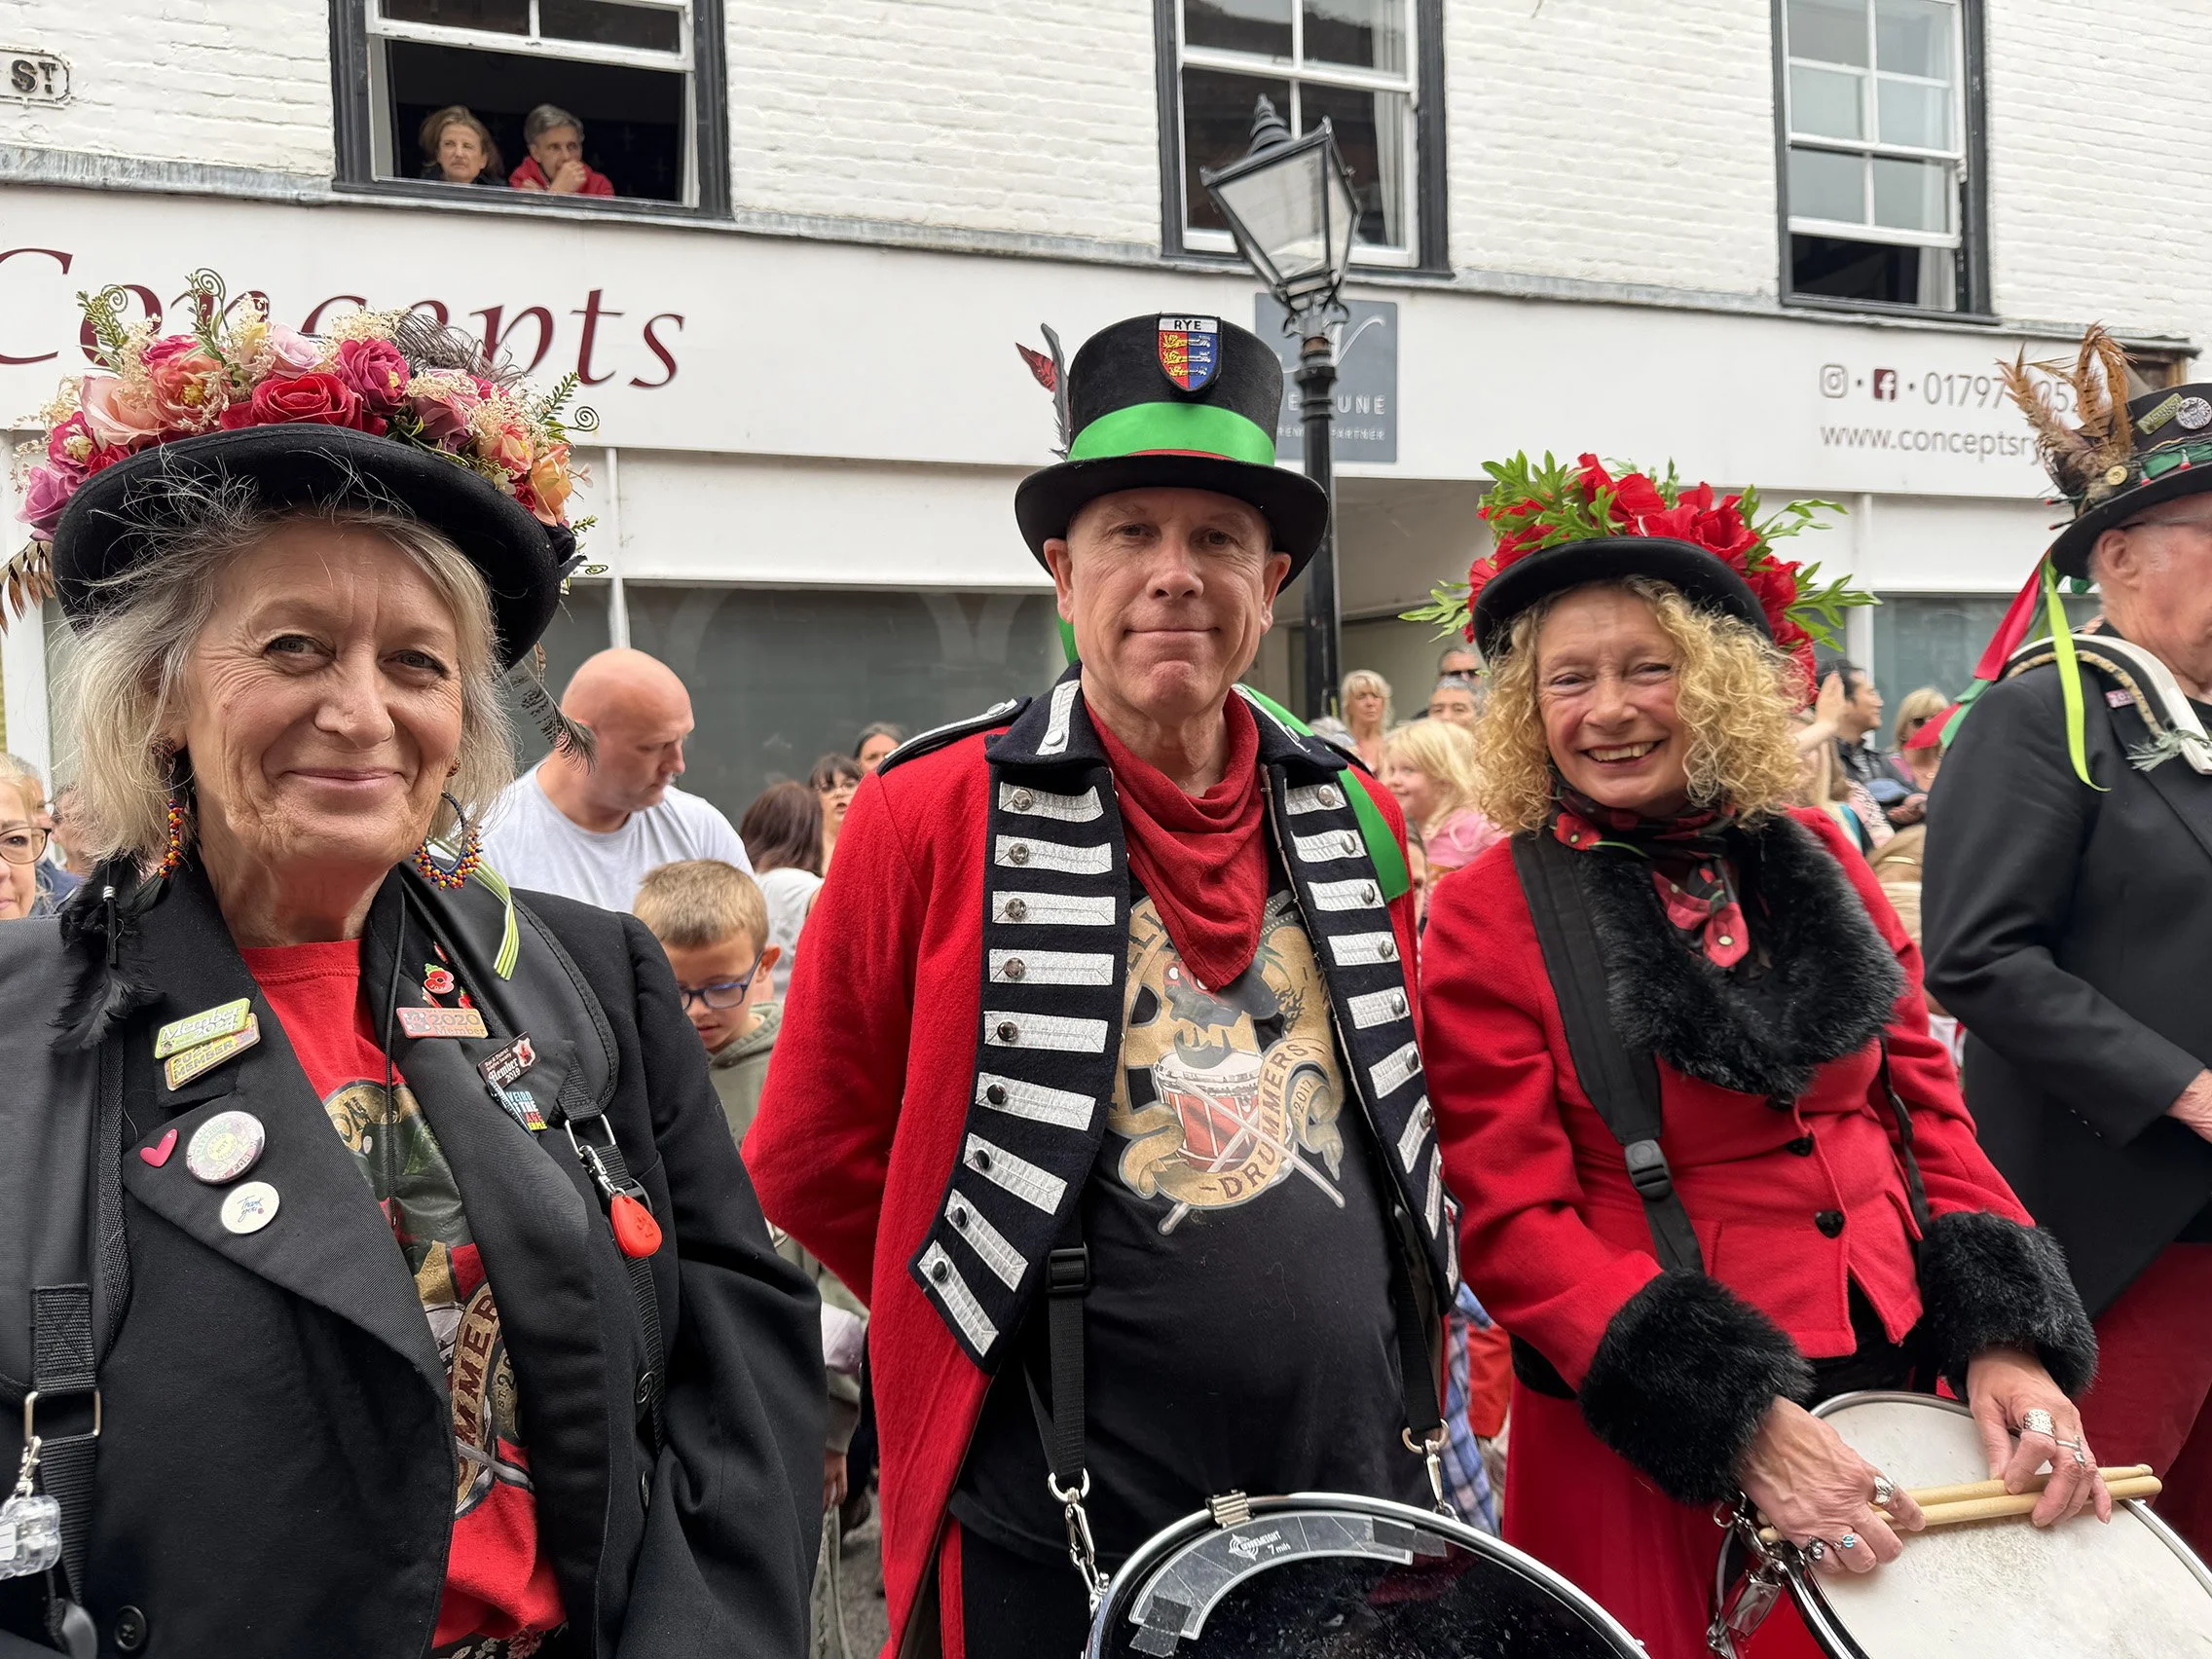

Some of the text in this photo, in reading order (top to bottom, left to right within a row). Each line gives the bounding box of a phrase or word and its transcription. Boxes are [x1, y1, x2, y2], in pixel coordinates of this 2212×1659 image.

[1173, 319, 1202, 330] RYE
[1923, 371, 2008, 410] 01797
[1286, 391, 1386, 415] EUNE
[162, 1006, 243, 1041] Member
[195, 1018, 237, 1039] 2024
[428, 1014, 481, 1025] 2020
[434, 1025, 485, 1036] Member
[174, 1040, 234, 1080] MEMBER
[488, 1057, 519, 1081] Member
[504, 1067, 521, 1084] 2019
[1294, 1079, 1313, 1115] 2017
[1267, 1543, 1275, 1555] 7
